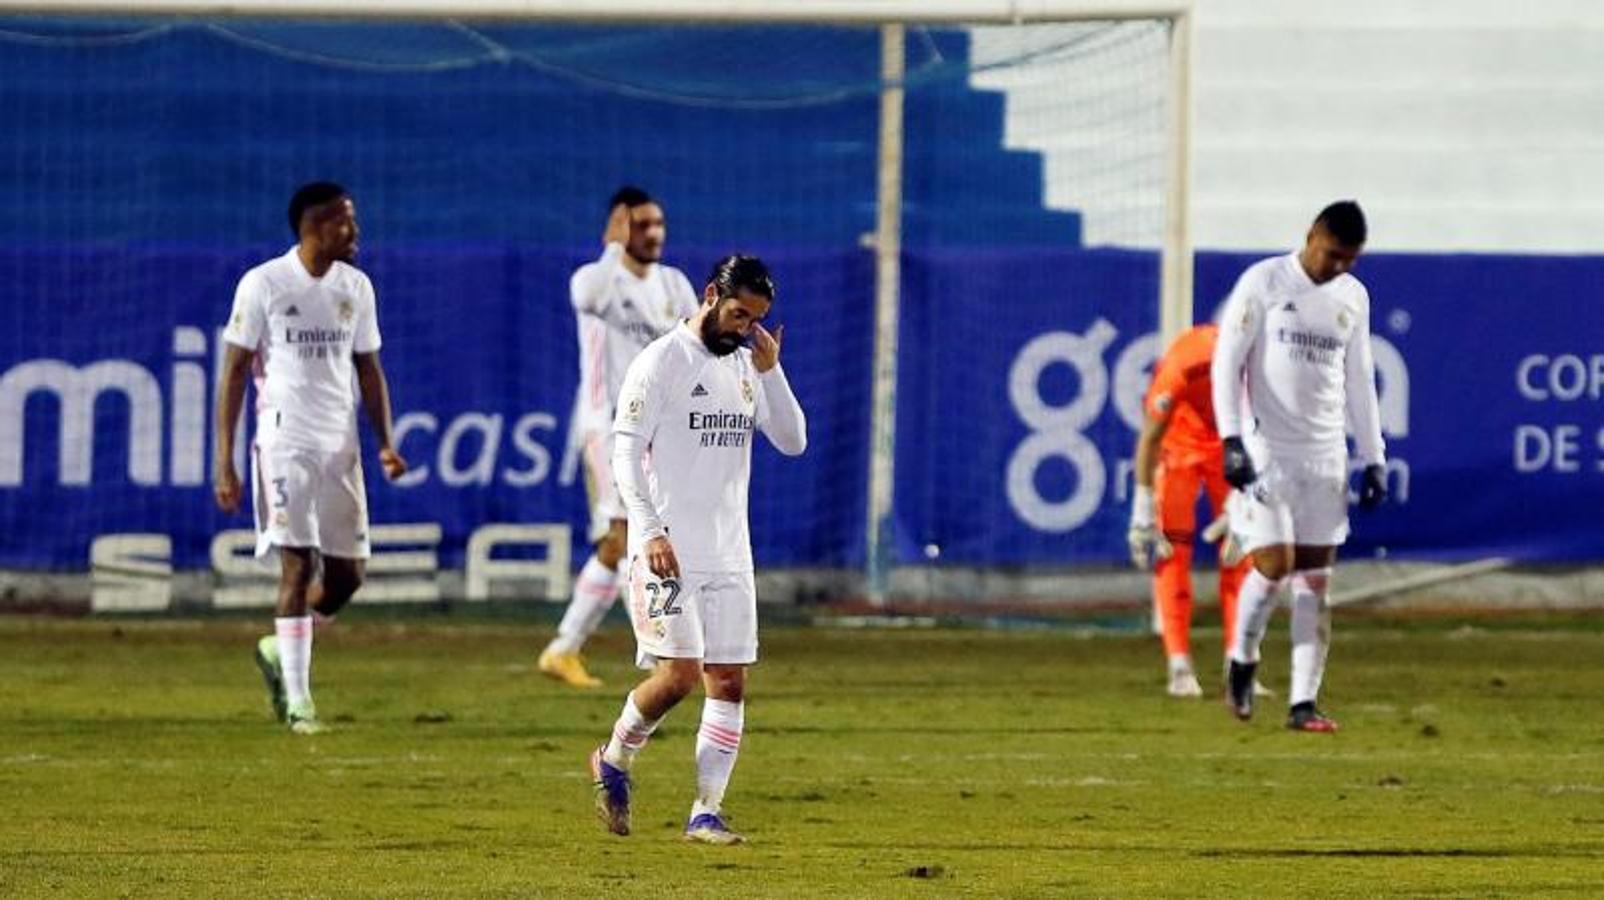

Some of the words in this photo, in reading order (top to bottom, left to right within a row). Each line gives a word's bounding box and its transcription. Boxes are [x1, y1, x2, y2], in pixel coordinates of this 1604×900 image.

[1515, 424, 1581, 473] DE
[271, 477, 288, 508] 3
[645, 579, 682, 619] 22
